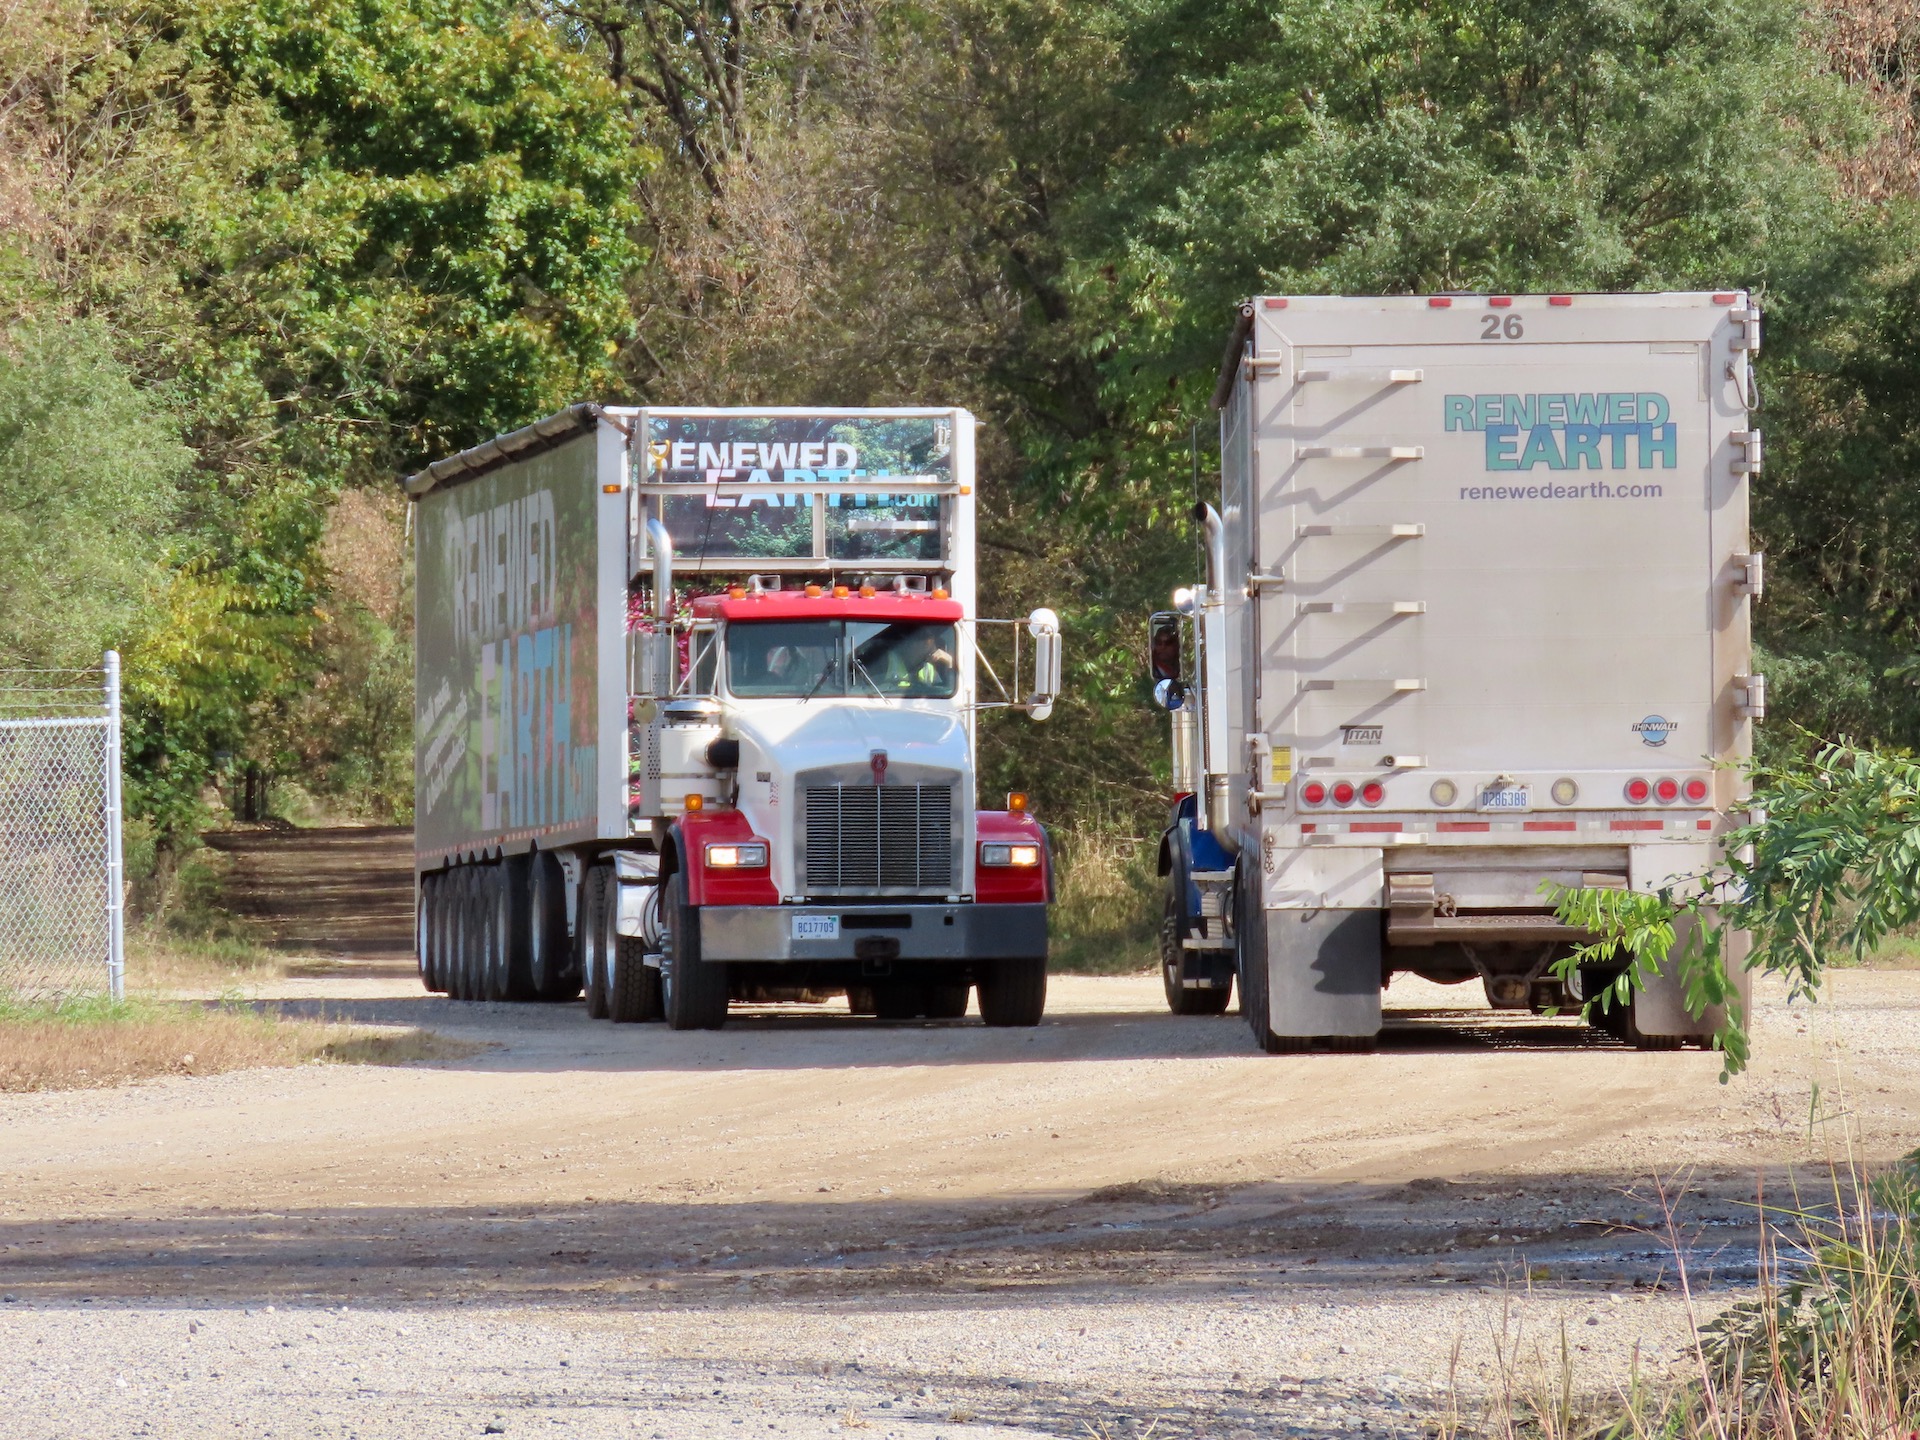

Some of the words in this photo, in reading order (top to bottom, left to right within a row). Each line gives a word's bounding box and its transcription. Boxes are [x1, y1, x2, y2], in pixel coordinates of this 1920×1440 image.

[1480, 313, 1524, 340] 26
[1444, 392, 1670, 431] RENEWED
[1485, 422, 1677, 471] EARTH
[1459, 481, 1662, 500] renewedearth.com
[453, 489, 556, 649] RENEWED
[482, 623, 571, 831] EARTH
[1339, 724, 1384, 745] TITAN
[1631, 721, 1678, 732] THINWALL
[798, 922, 834, 933] BC17709
